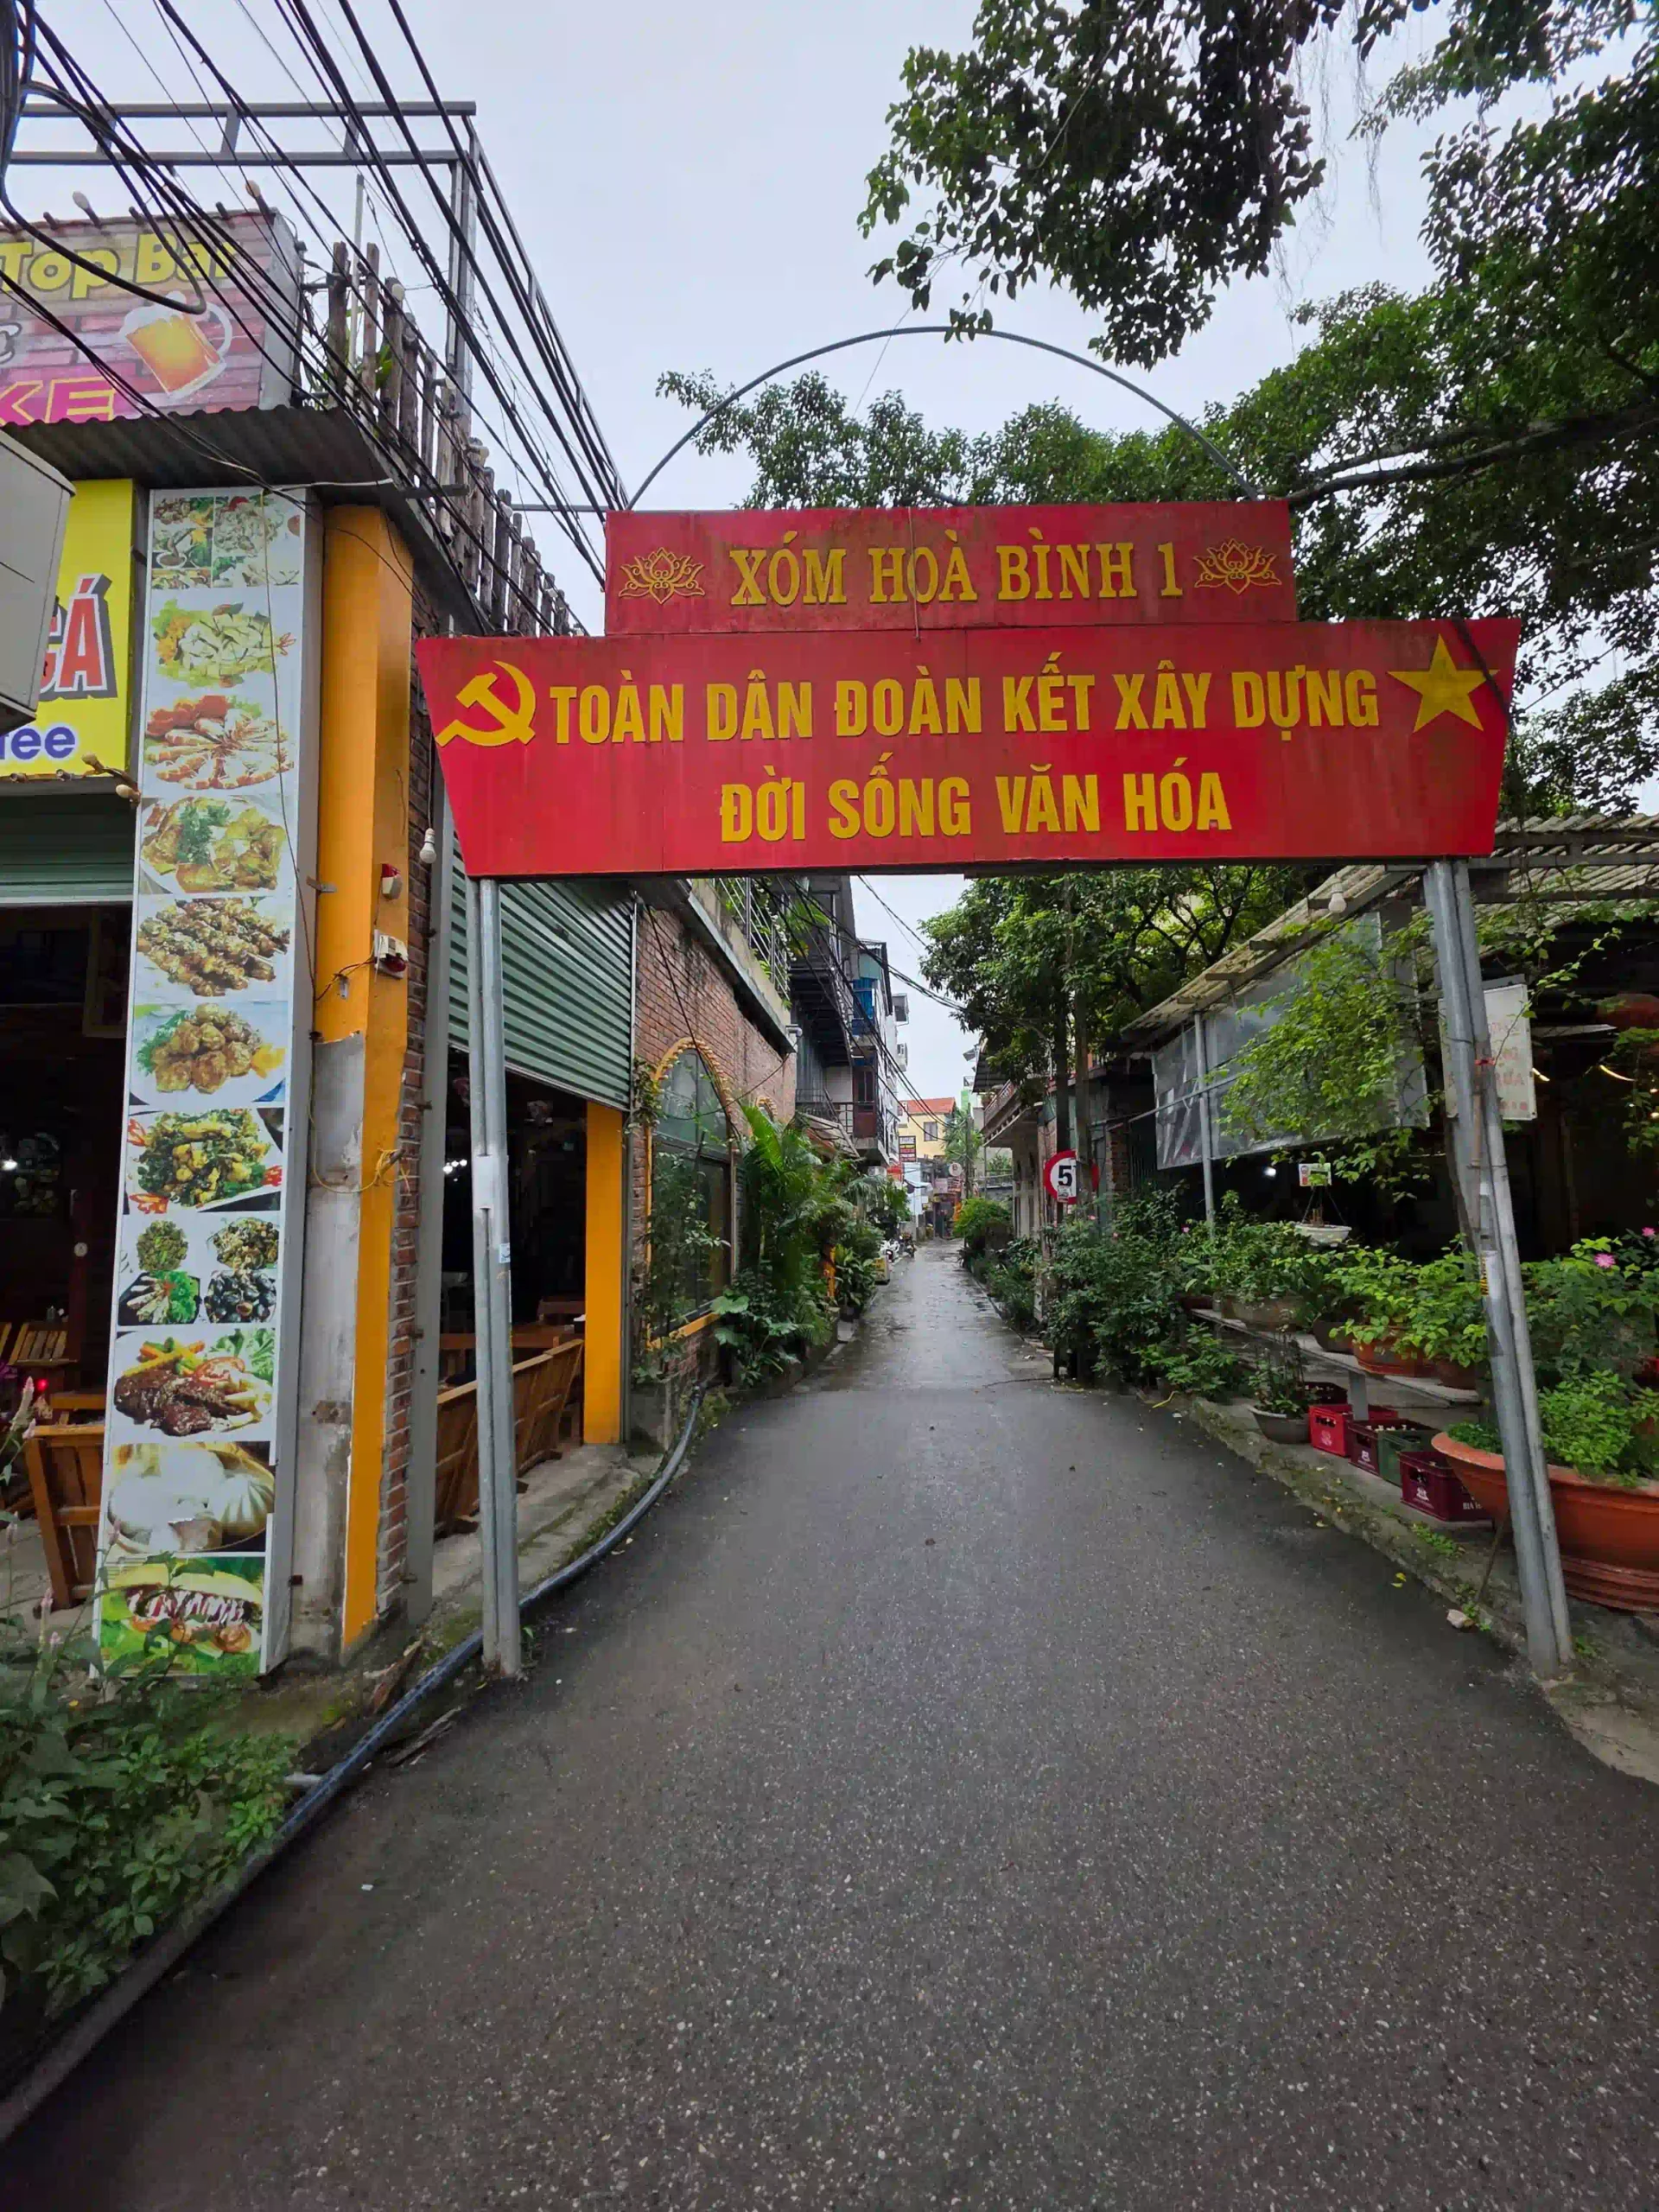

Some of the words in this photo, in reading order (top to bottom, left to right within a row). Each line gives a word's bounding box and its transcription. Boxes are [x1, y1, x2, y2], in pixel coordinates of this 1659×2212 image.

[729, 532, 848, 606] XÓM
[868, 530, 979, 604] HOÀ
[995, 529, 1136, 601] BÌNH
[1158, 543, 1183, 596] 1
[40, 574, 112, 694] Á
[550, 671, 684, 744] TOÀN
[707, 670, 813, 741] DÂN
[834, 666, 982, 737] ĐOÀN
[1002, 652, 1095, 732] KẾT
[1114, 660, 1211, 730] XÂY
[1231, 664, 1380, 741] DỰNG
[720, 766, 805, 842] ĐỜI
[828, 753, 972, 839] SỐNG
[995, 764, 1101, 835] VĂN
[1123, 757, 1232, 832] HÓA
[1058, 1165, 1073, 1186] 5
